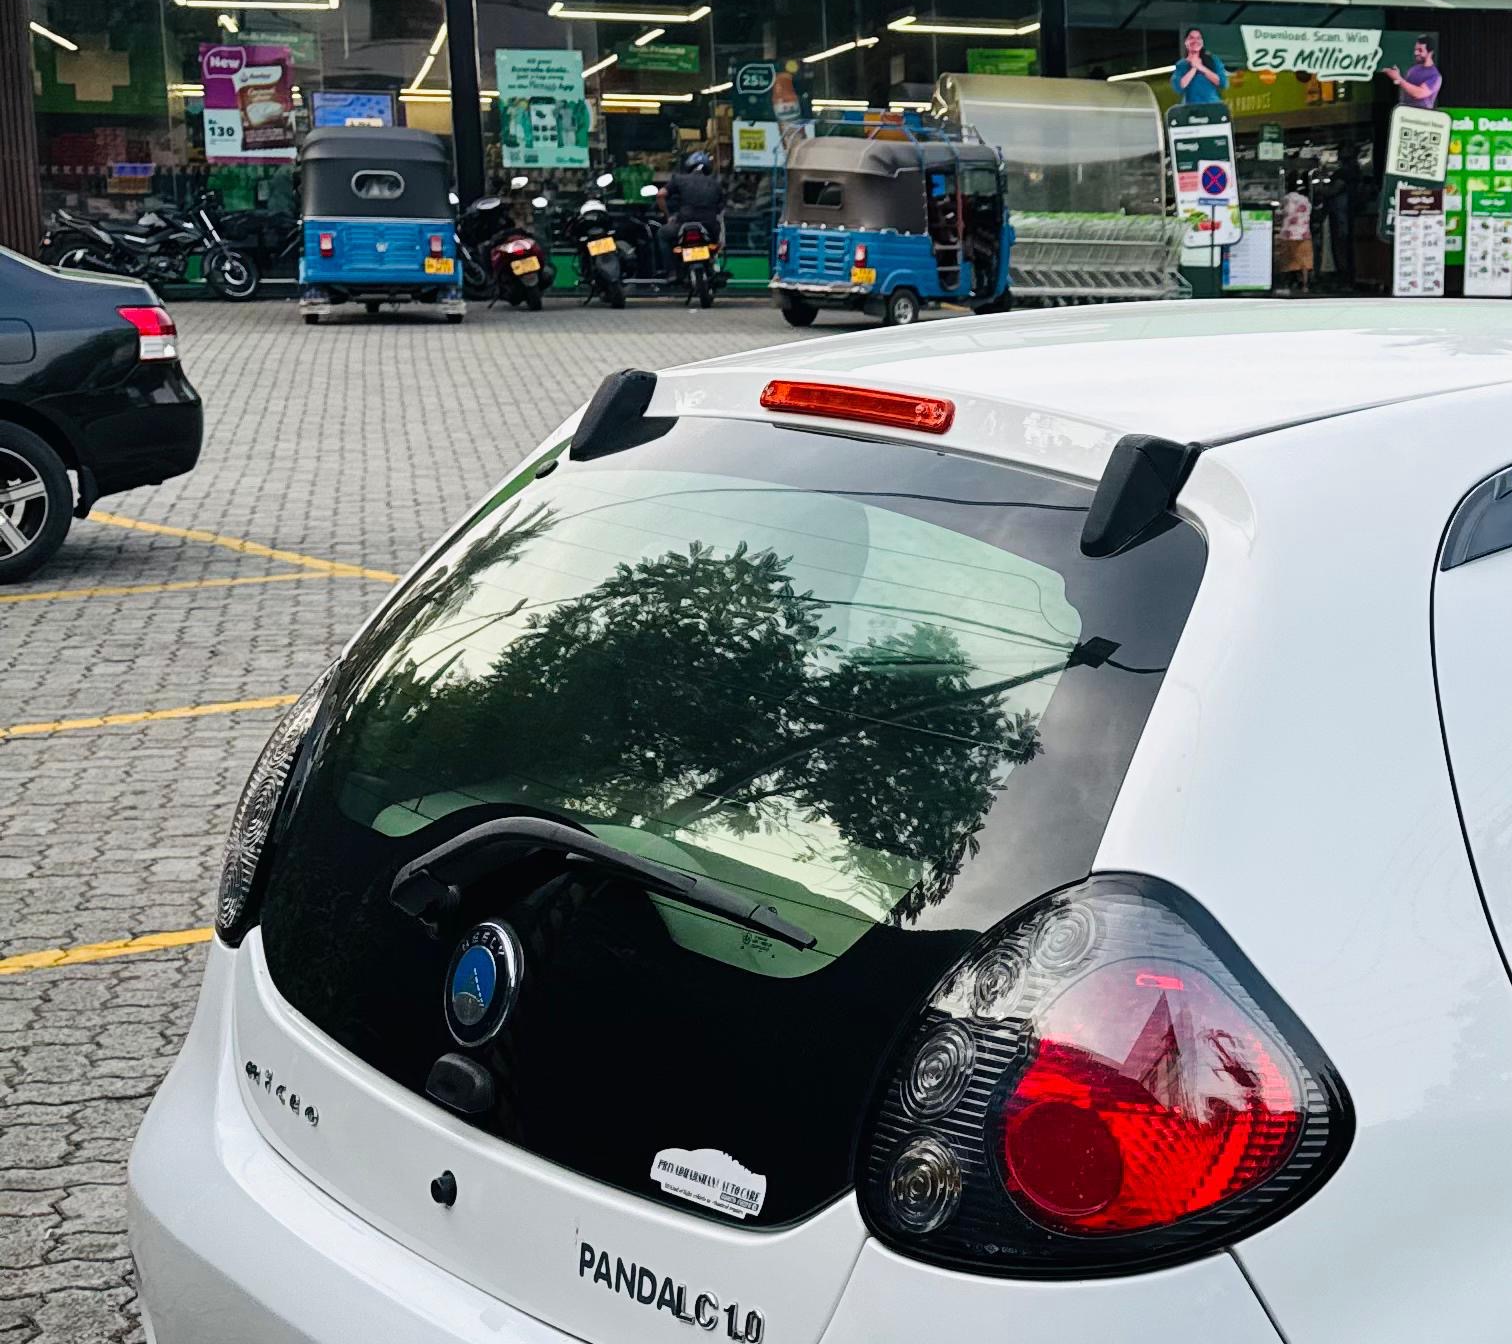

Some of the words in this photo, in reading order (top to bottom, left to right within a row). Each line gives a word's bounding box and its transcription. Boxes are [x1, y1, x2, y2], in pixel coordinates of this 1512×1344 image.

[1254, 29, 1310, 41] Download.
[1313, 31, 1342, 42] Scan.
[1346, 33, 1369, 43] Win
[210, 55, 240, 68] New
[1252, 48, 1288, 68] 25
[1293, 47, 1378, 71] Million!
[208, 126, 235, 137] 130
